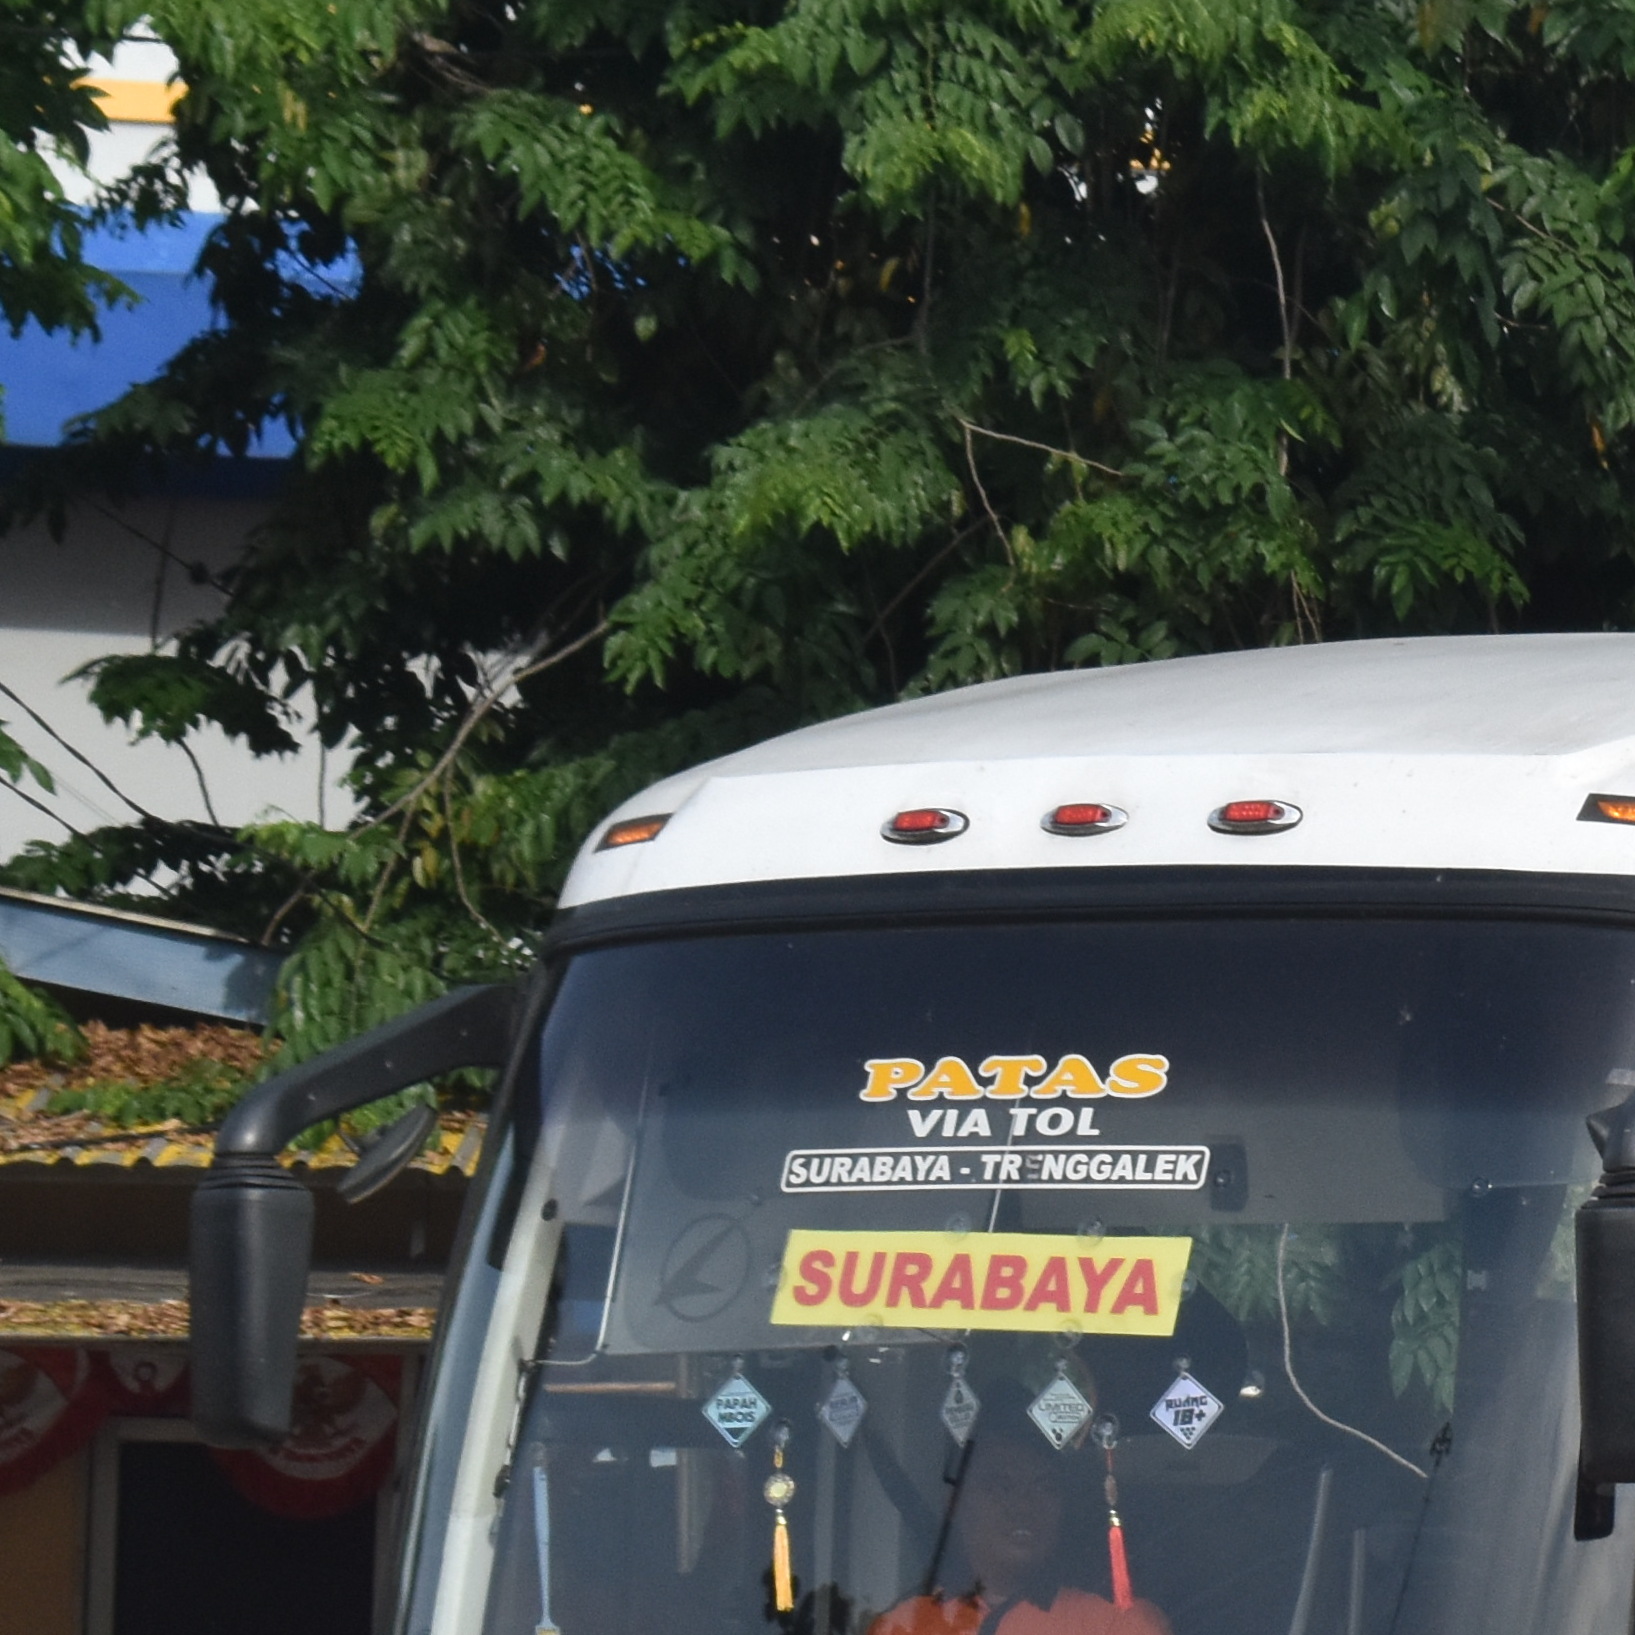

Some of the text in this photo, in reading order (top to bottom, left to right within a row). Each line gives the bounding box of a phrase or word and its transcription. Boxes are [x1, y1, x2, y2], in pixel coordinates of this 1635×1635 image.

[859, 1053, 1170, 1101] PATAS
[907, 1106, 1101, 1138] VIA TOL
[788, 1155, 952, 1185] SURABAYA
[791, 1248, 1160, 1317] SURABAYA
